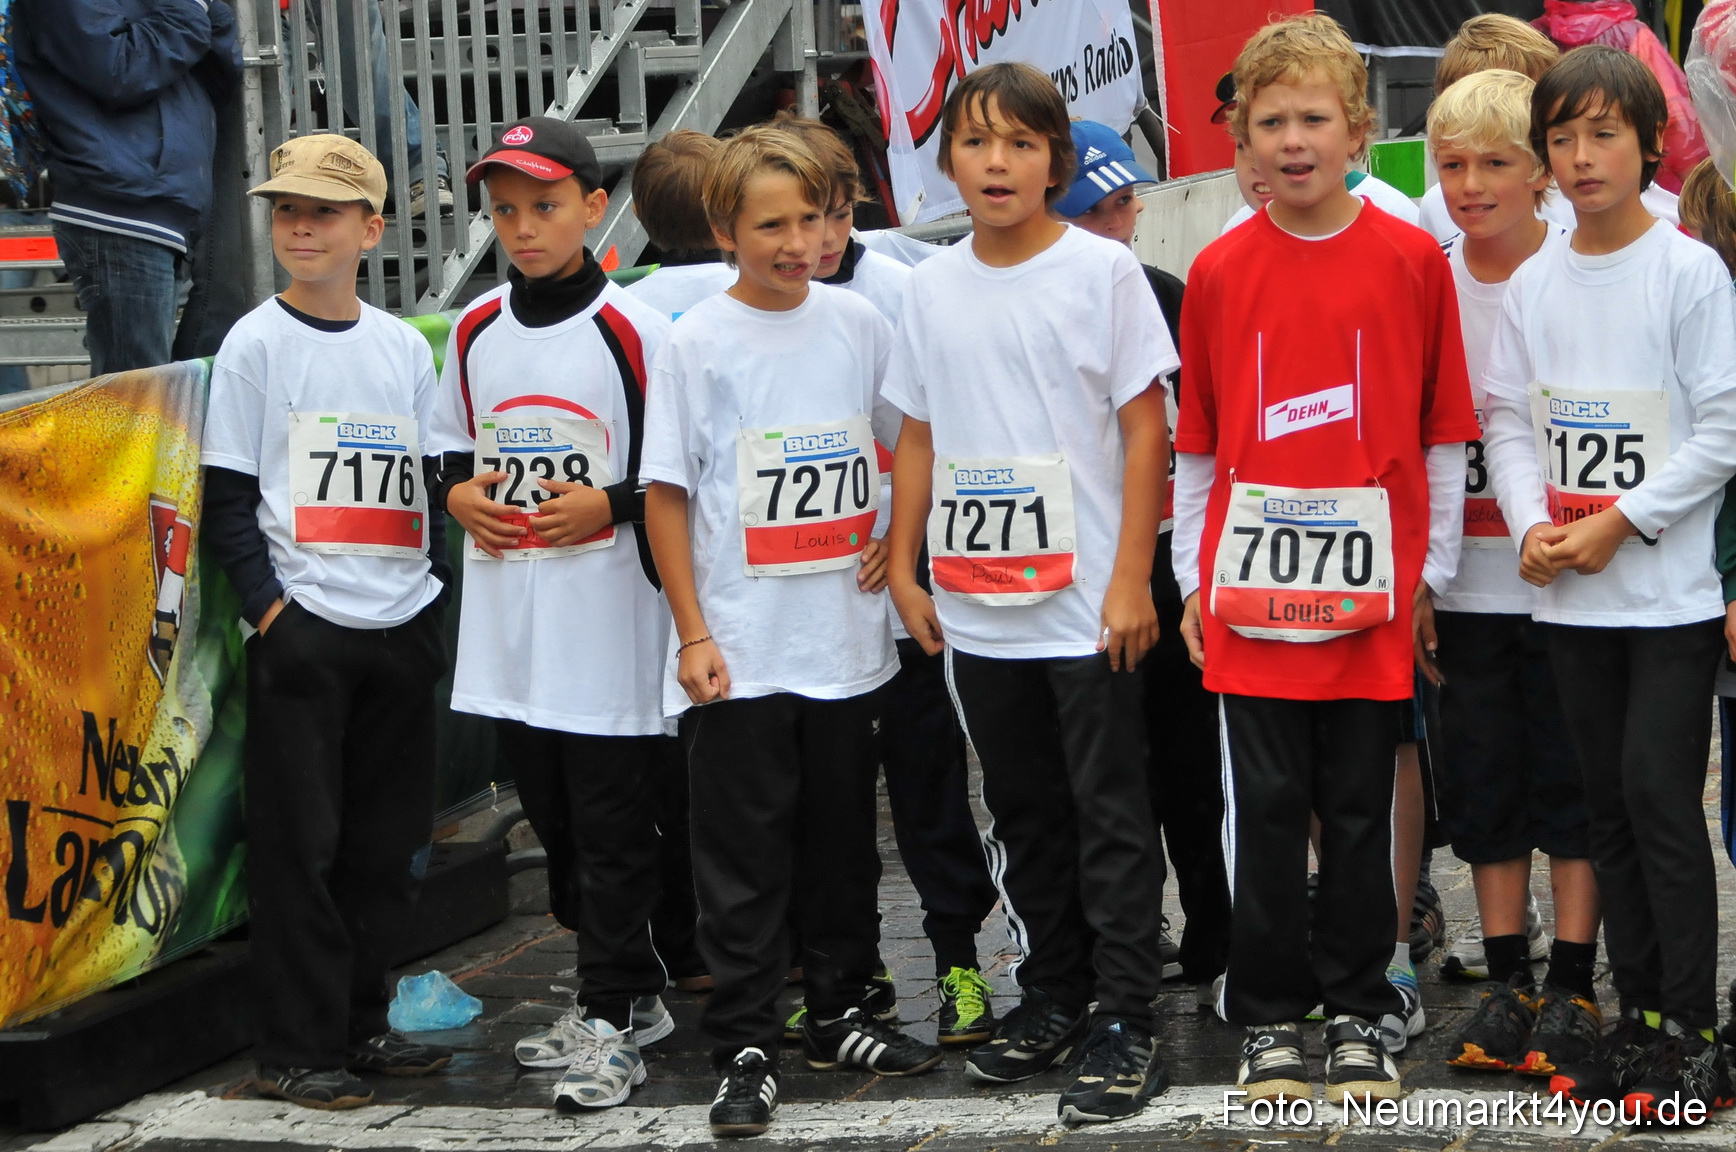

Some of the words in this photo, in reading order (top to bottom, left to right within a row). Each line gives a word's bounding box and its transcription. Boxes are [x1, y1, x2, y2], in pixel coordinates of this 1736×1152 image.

[1083, 28, 1134, 95] Radio
[504, 133, 530, 142] FCN
[1084, 152, 1107, 166] adidas
[1287, 399, 1329, 423] DEHN
[1550, 398, 1610, 418] BOCK
[337, 423, 397, 440] BOCK
[496, 427, 552, 444] BOCK
[784, 430, 848, 453] BOCK
[309, 451, 415, 507] 7176
[481, 453, 594, 508] 7238
[955, 468, 1015, 485] BOCK
[756, 456, 870, 521] 7270
[1264, 498, 1338, 516] BOCK
[940, 496, 1049, 552] 7271
[794, 527, 846, 550] Louis
[1232, 526, 1374, 587] 7070
[1220, 573, 1226, 583] 6
[1378, 578, 1387, 589] M
[1268, 597, 1335, 623] Louis
